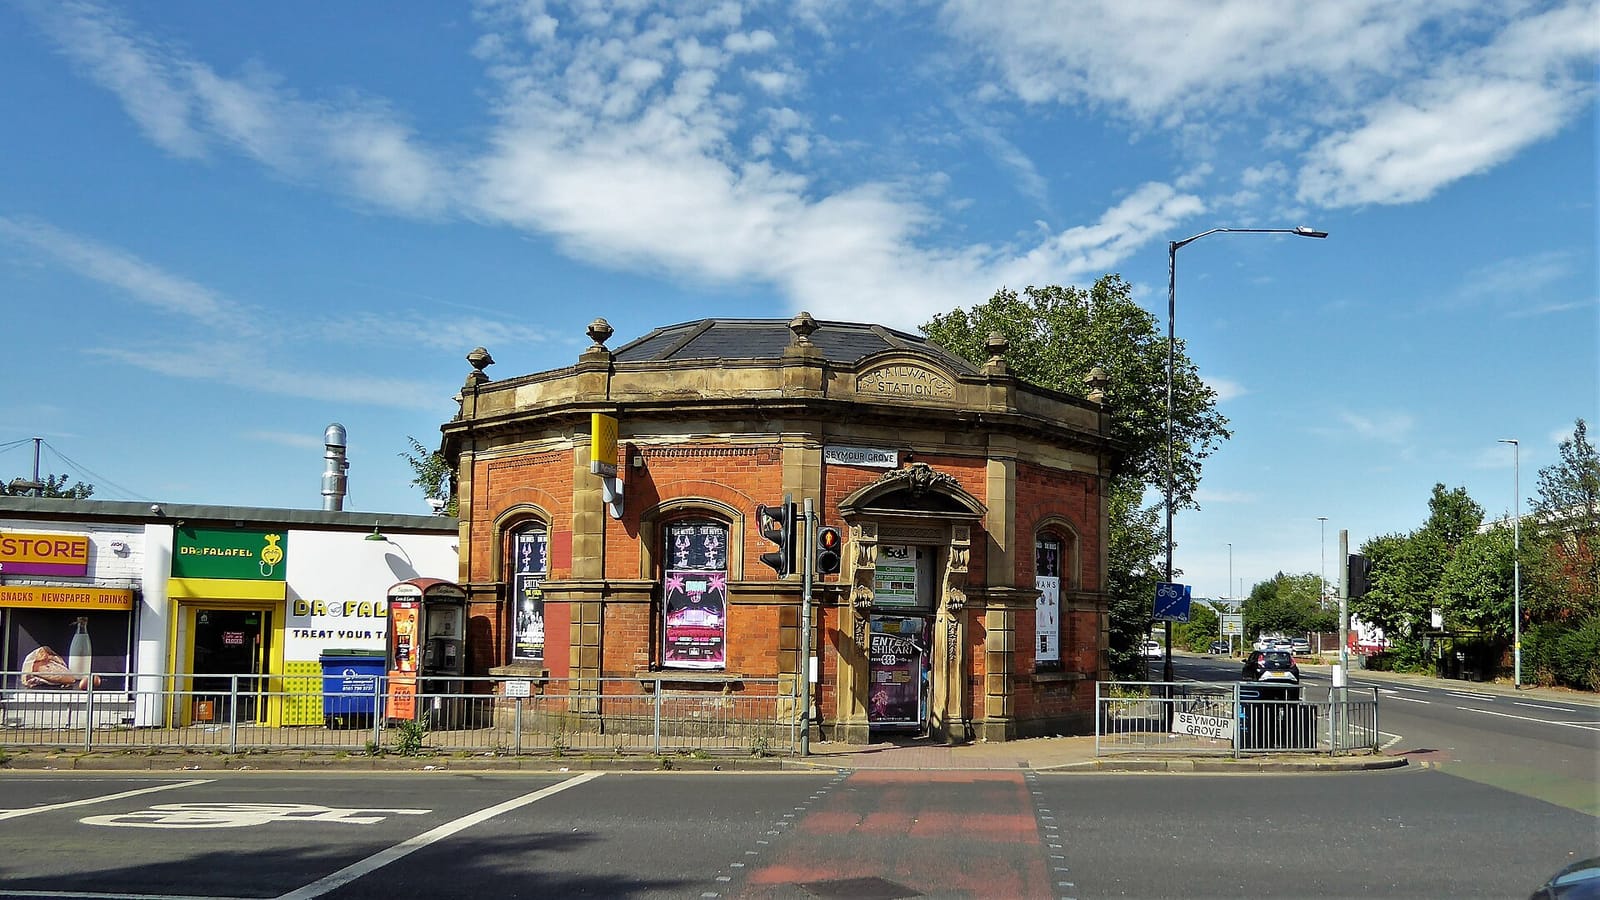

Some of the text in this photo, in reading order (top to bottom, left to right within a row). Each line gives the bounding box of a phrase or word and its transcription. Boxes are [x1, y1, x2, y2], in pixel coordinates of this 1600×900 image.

[875, 366, 936, 384] RAILWAY
[878, 381, 932, 395] STATION
[825, 450, 865, 461] SEYMOUR
[1, 538, 85, 558] STORE
[203, 547, 253, 557] FALAFEL
[1, 592, 128, 605] SNACKS NEWSPAPER DRINKS
[293, 629, 334, 639] TREAT
[337, 630, 372, 639] YOUR
[871, 636, 911, 647] ENTER
[871, 646, 913, 655] SHIKARI
[1180, 714, 1229, 729] SEYMOUR
[1187, 725, 1221, 737] GROVE
